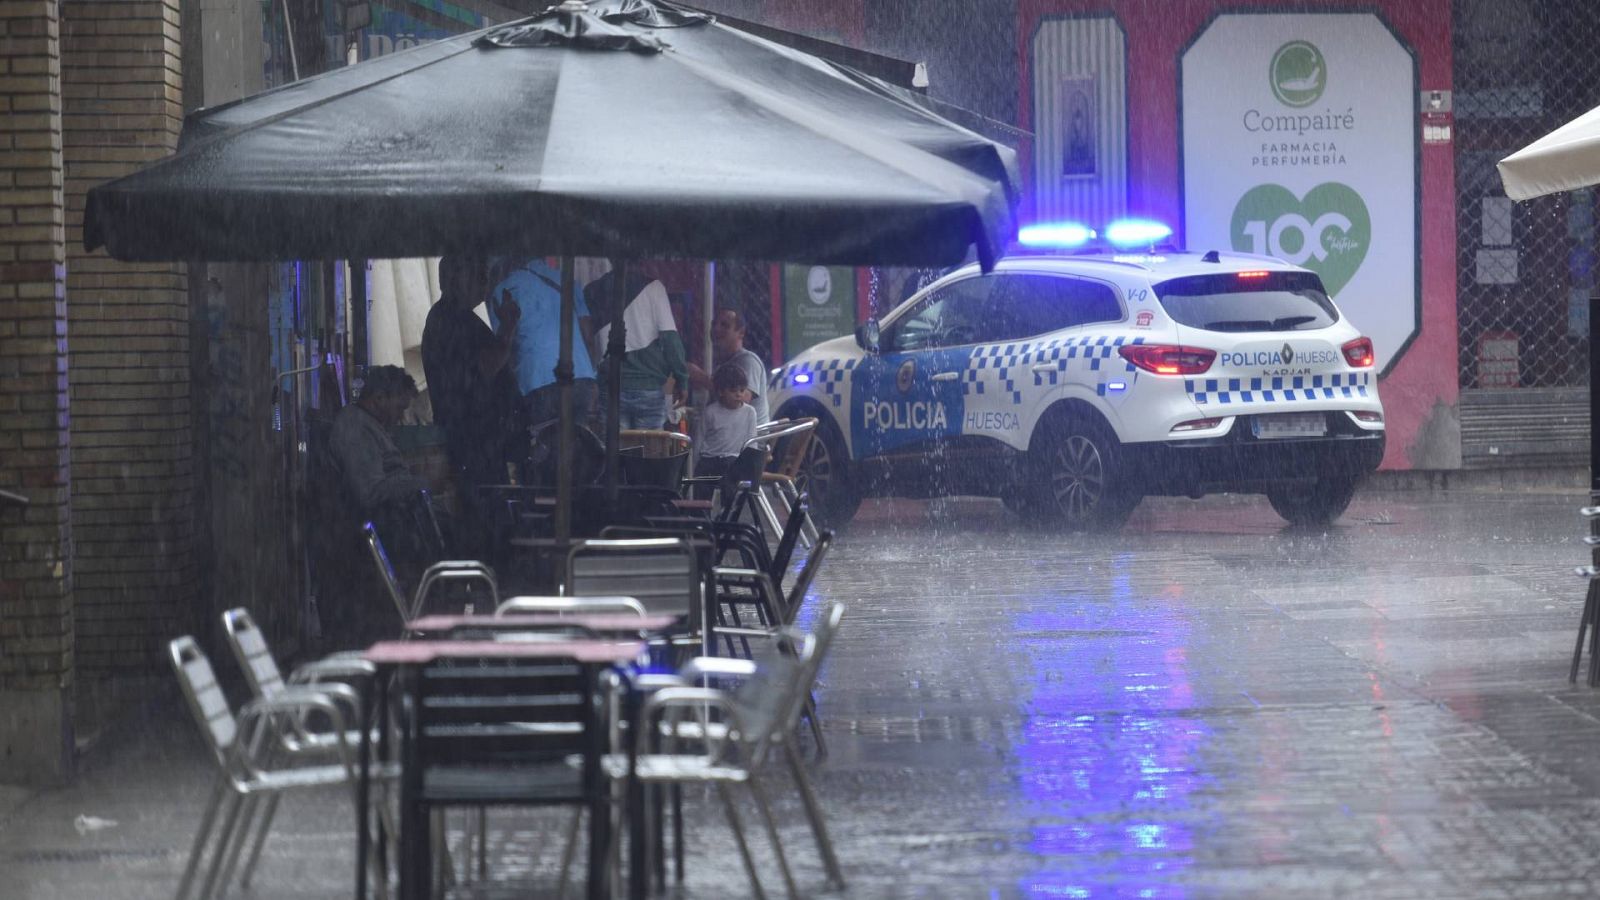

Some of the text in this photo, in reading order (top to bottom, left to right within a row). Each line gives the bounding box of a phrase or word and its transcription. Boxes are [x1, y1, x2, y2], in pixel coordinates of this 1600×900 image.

[1243, 108, 1355, 136] Compairé
[1261, 142, 1337, 153] FARMACIA
[1252, 155, 1347, 167] PERFUMERÍA
[1221, 351, 1339, 367] POLICIA HUESCA
[1262, 368, 1311, 377] KADJAR
[864, 401, 1021, 430] POLICIA HUESCA
